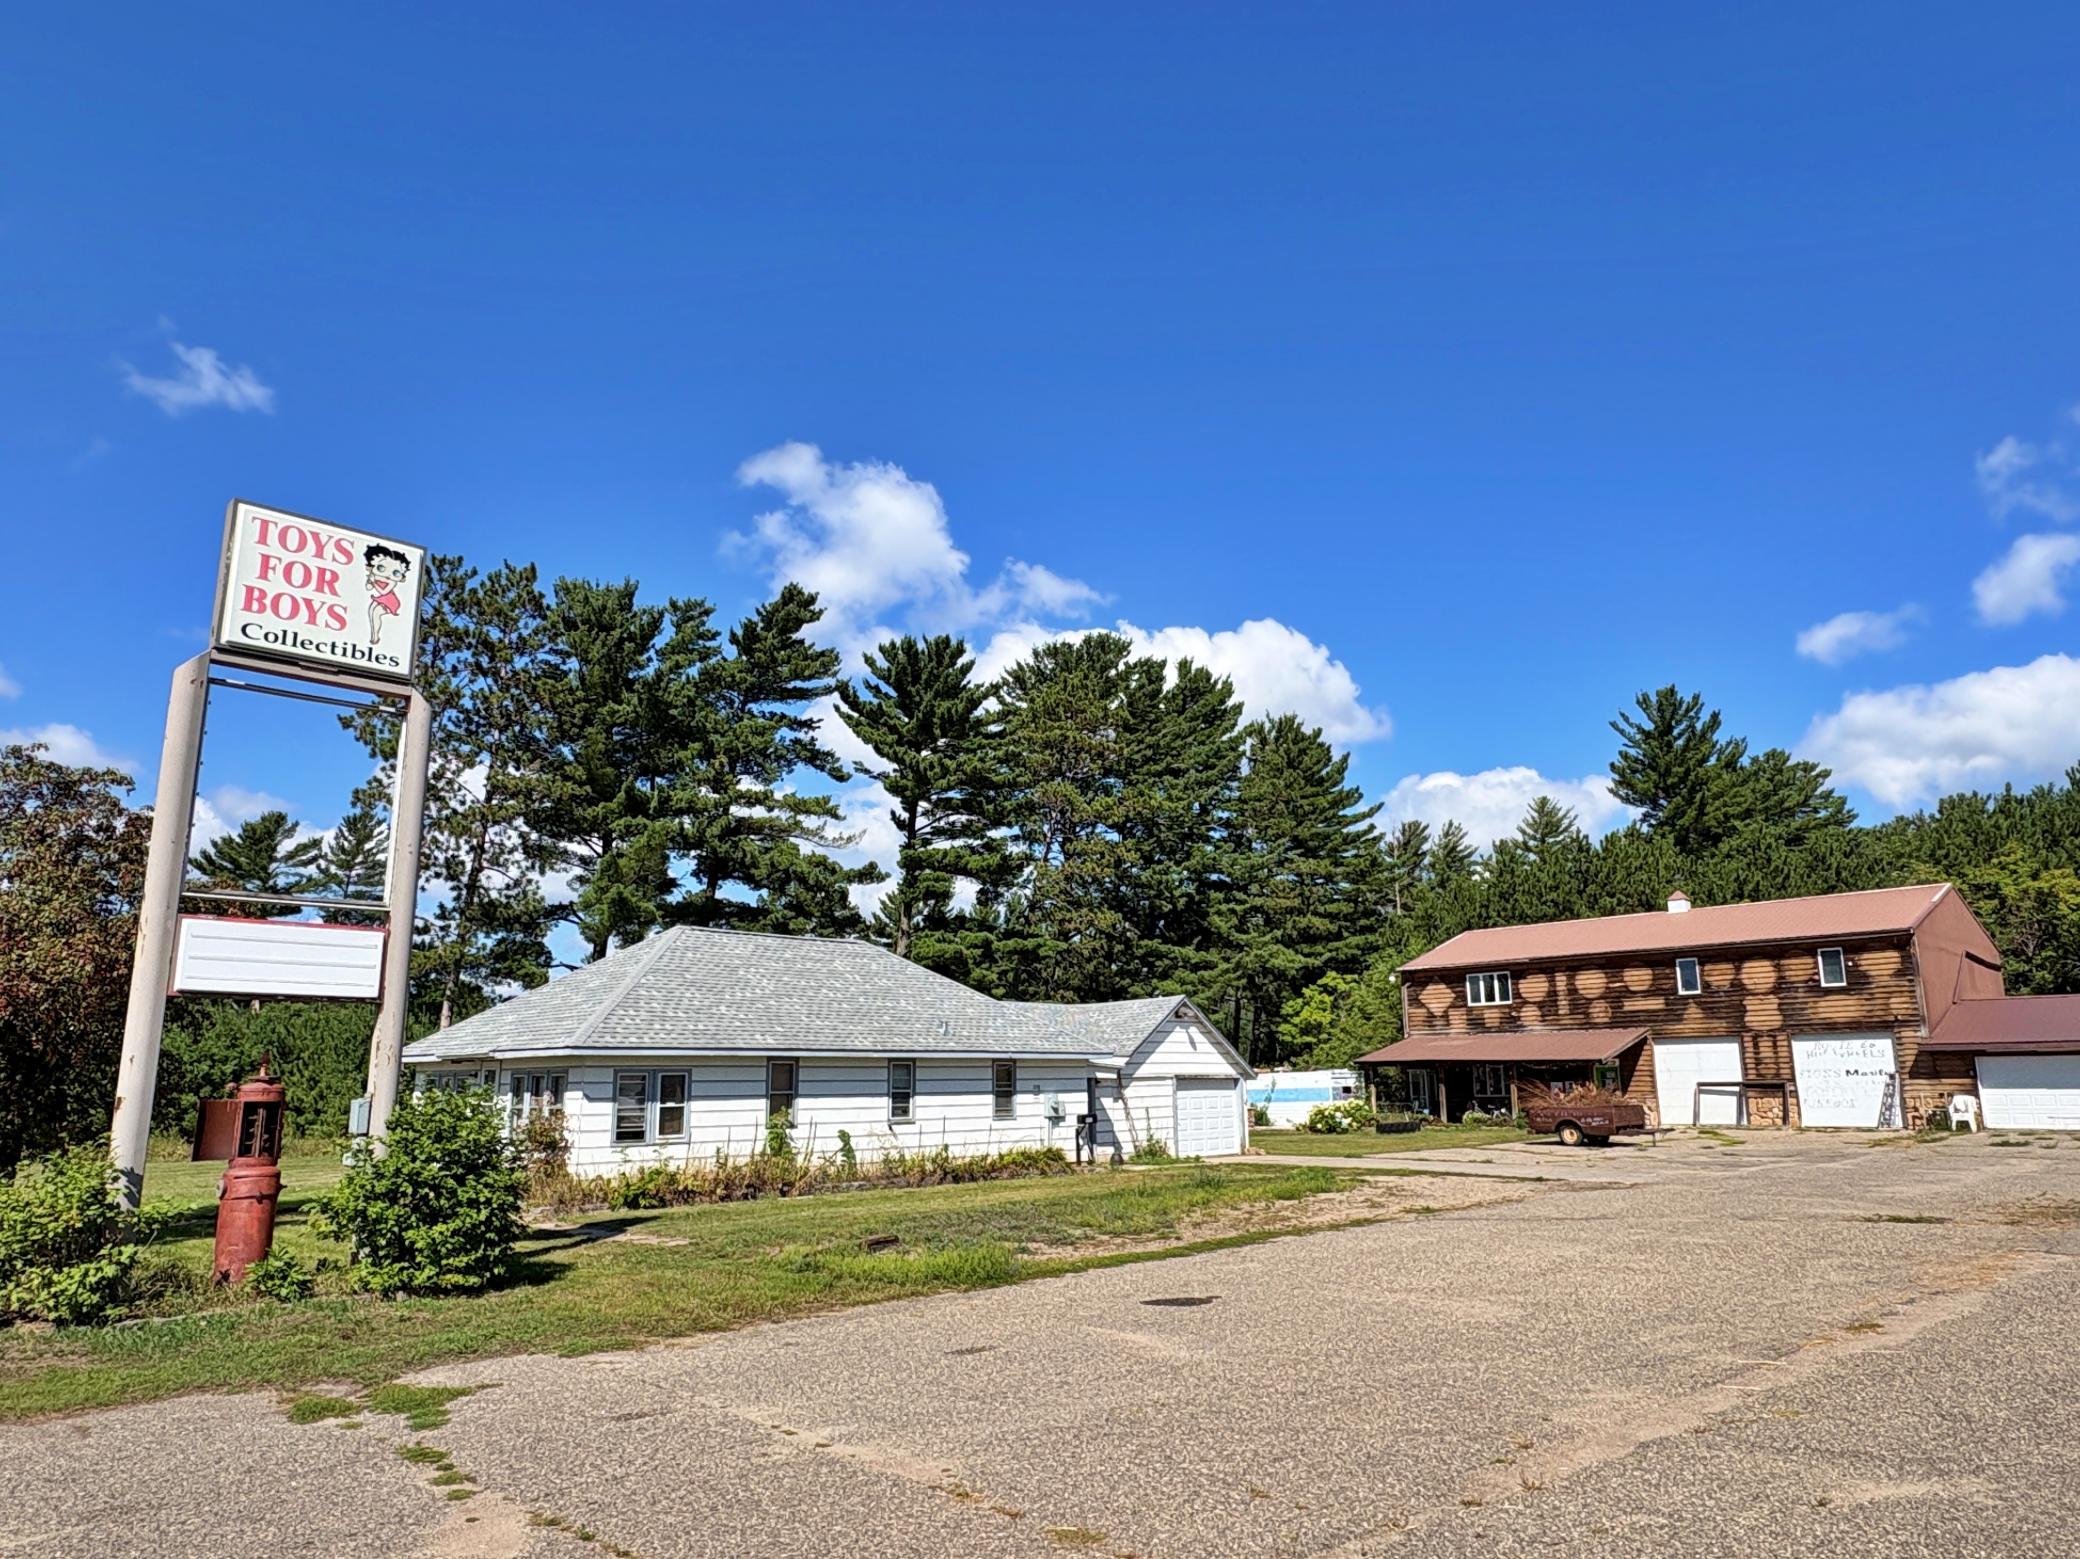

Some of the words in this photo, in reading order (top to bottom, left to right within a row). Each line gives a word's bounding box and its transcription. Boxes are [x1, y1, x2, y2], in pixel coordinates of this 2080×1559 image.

[252, 516, 355, 566] TOYS
[256, 552, 341, 597] FOR
[240, 584, 348, 631] BOYS
[241, 623, 400, 668] Collectibles
